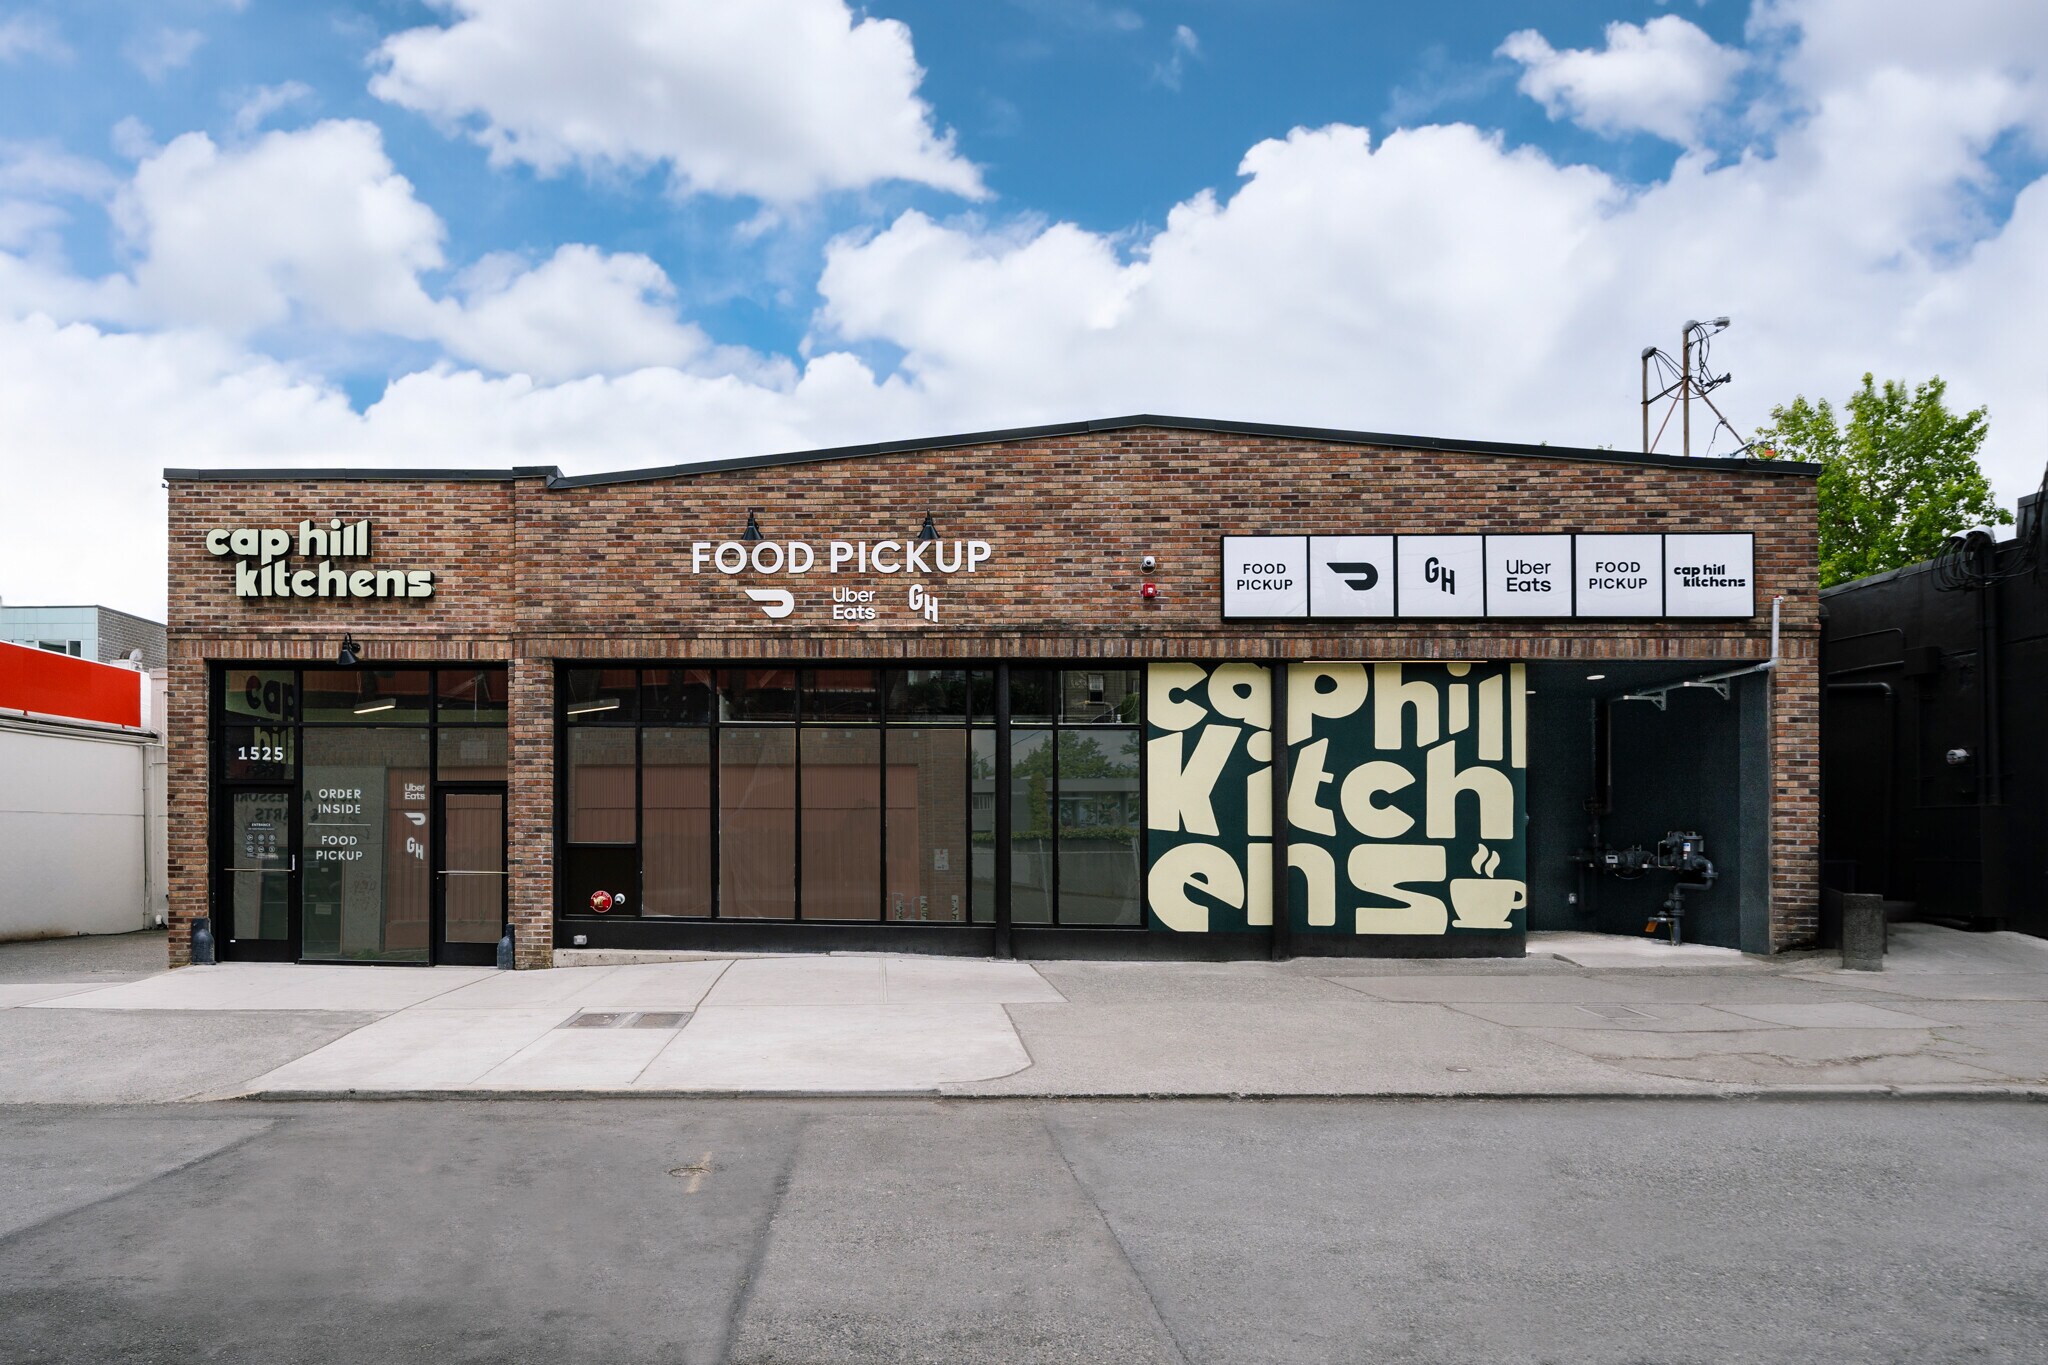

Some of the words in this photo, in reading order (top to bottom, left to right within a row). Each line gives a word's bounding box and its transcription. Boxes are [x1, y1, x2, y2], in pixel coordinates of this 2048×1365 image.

[206, 528, 290, 566] cap
[299, 519, 372, 557] hill
[692, 541, 815, 575] FOOD
[830, 540, 992, 574] PICKUP
[1243, 563, 1287, 575] FOOD
[1506, 559, 1551, 575] Uber
[1595, 561, 1641, 573] FOOD
[1673, 566, 1701, 577] cap
[1703, 564, 1726, 575] hill
[235, 560, 435, 598] kitchens
[1424, 556, 1456, 596] GH
[1683, 576, 1746, 587] kitchens
[1236, 579, 1293, 591] PICKUP
[1506, 577, 1552, 593] Eats
[1588, 577, 1648, 590] PICKUP
[832, 586, 876, 603] Uber
[908, 583, 939, 623] GH
[832, 604, 876, 620] Eats
[238, 746, 284, 761] 1525
[318, 788, 362, 799] ORDER
[404, 783, 426, 792] Uber
[404, 792, 426, 800] Eats
[318, 803, 361, 814] INSIDE
[321, 835, 358, 846] FOOD
[406, 836, 424, 860] GH
[316, 850, 363, 861] PICKUP
[1147, 842, 1449, 936] ens
